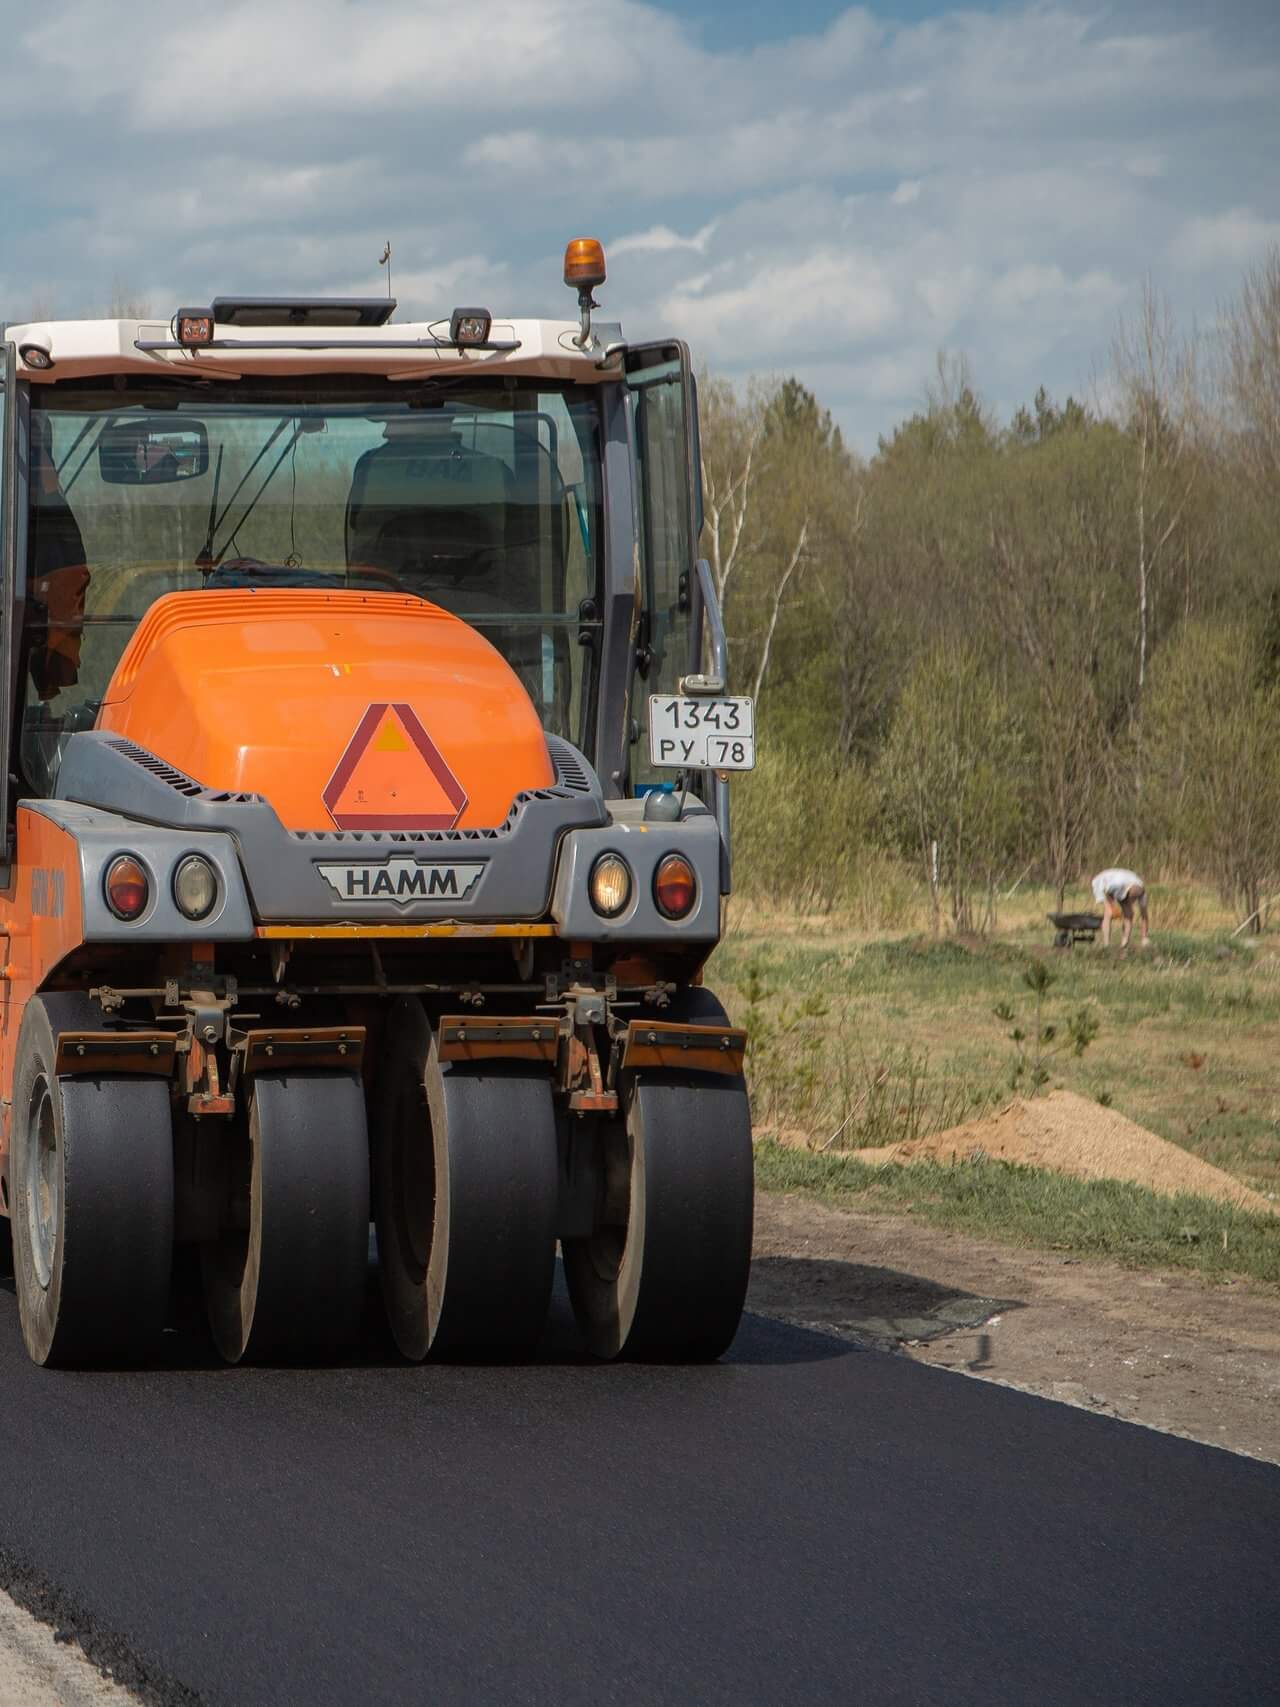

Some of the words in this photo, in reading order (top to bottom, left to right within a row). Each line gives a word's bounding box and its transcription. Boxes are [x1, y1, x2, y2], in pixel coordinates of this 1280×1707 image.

[665, 701, 739, 729] 1343
[660, 739, 695, 761] РУ
[716, 741, 745, 763] 78
[346, 869, 458, 895] HAMM
